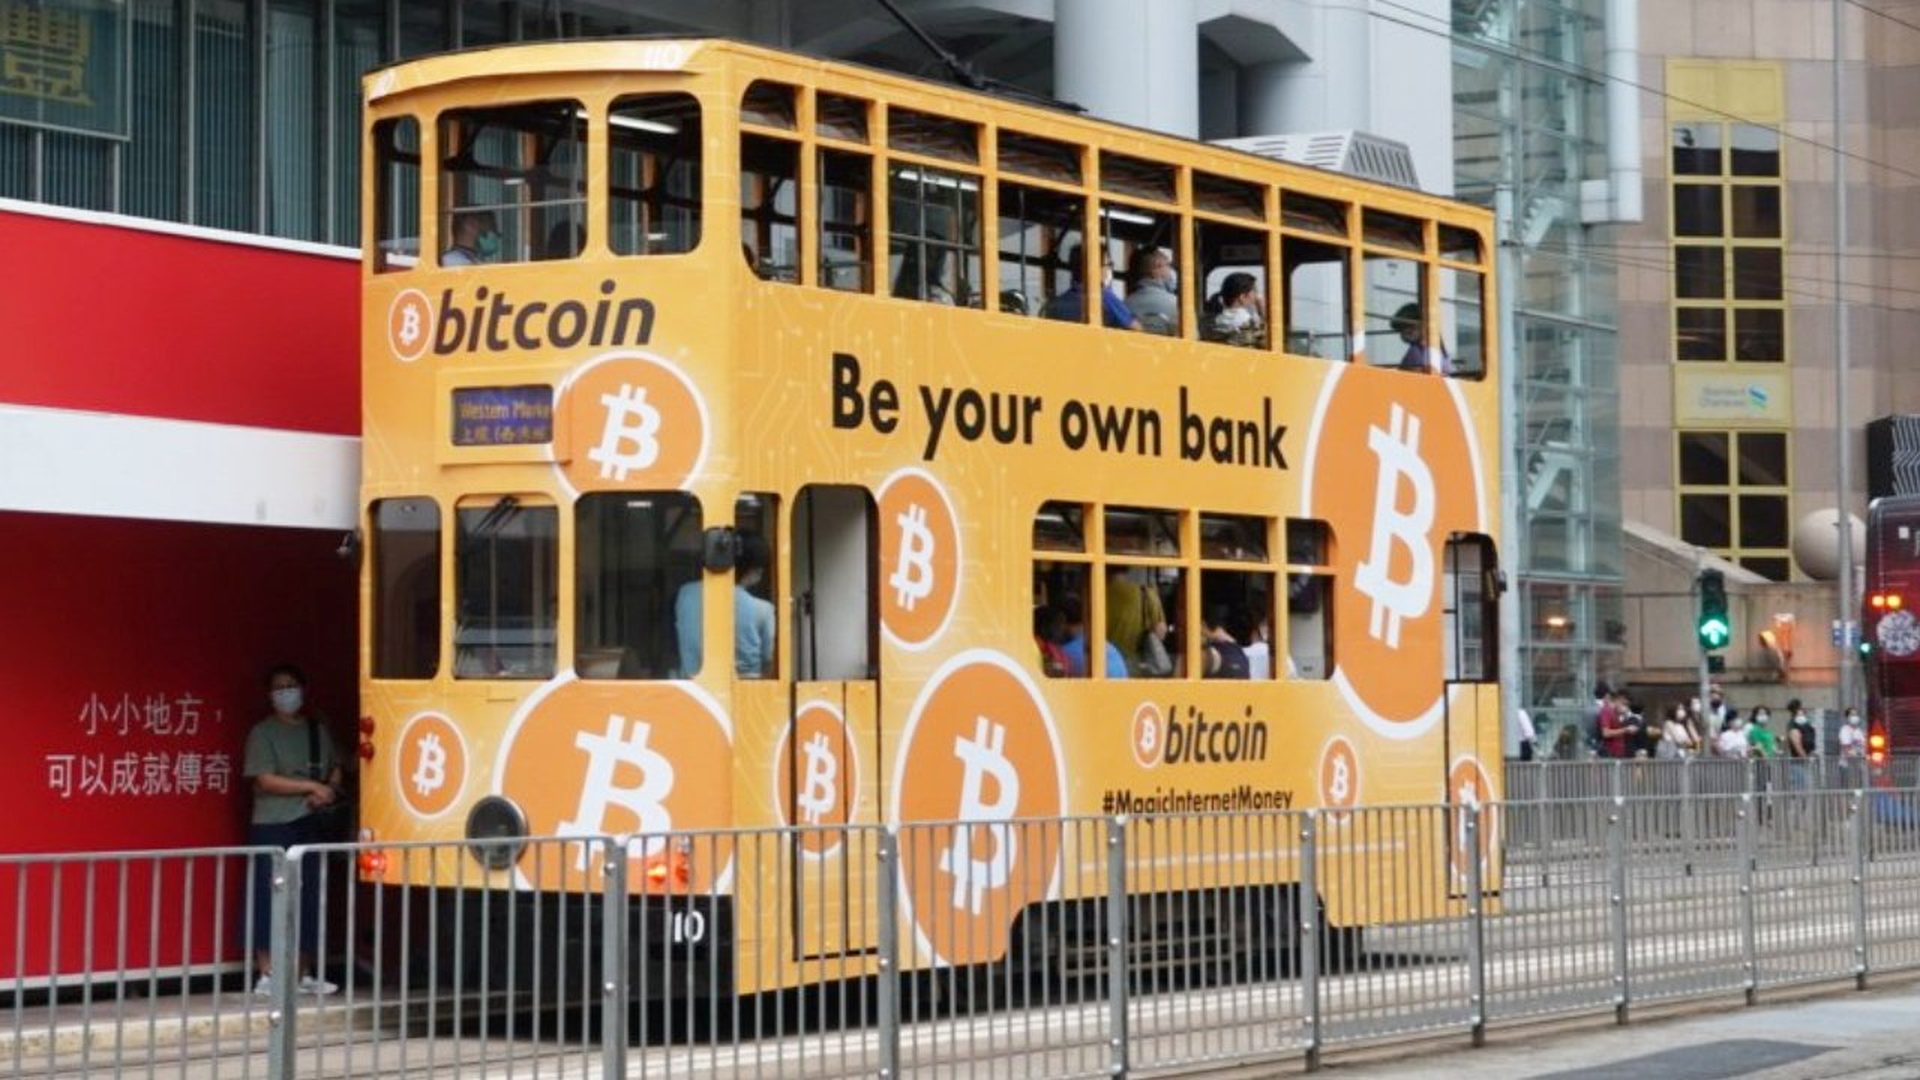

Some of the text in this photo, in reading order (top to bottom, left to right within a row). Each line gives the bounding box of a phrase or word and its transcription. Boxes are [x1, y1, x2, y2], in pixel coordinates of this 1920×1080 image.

[434, 279, 656, 355] bitcoin
[832, 352, 1289, 470] Be your own bank
[1164, 704, 1267, 764] bitcoin
[46, 751, 231, 798] 可以成就傳奇
[666, 911, 705, 943] 10
